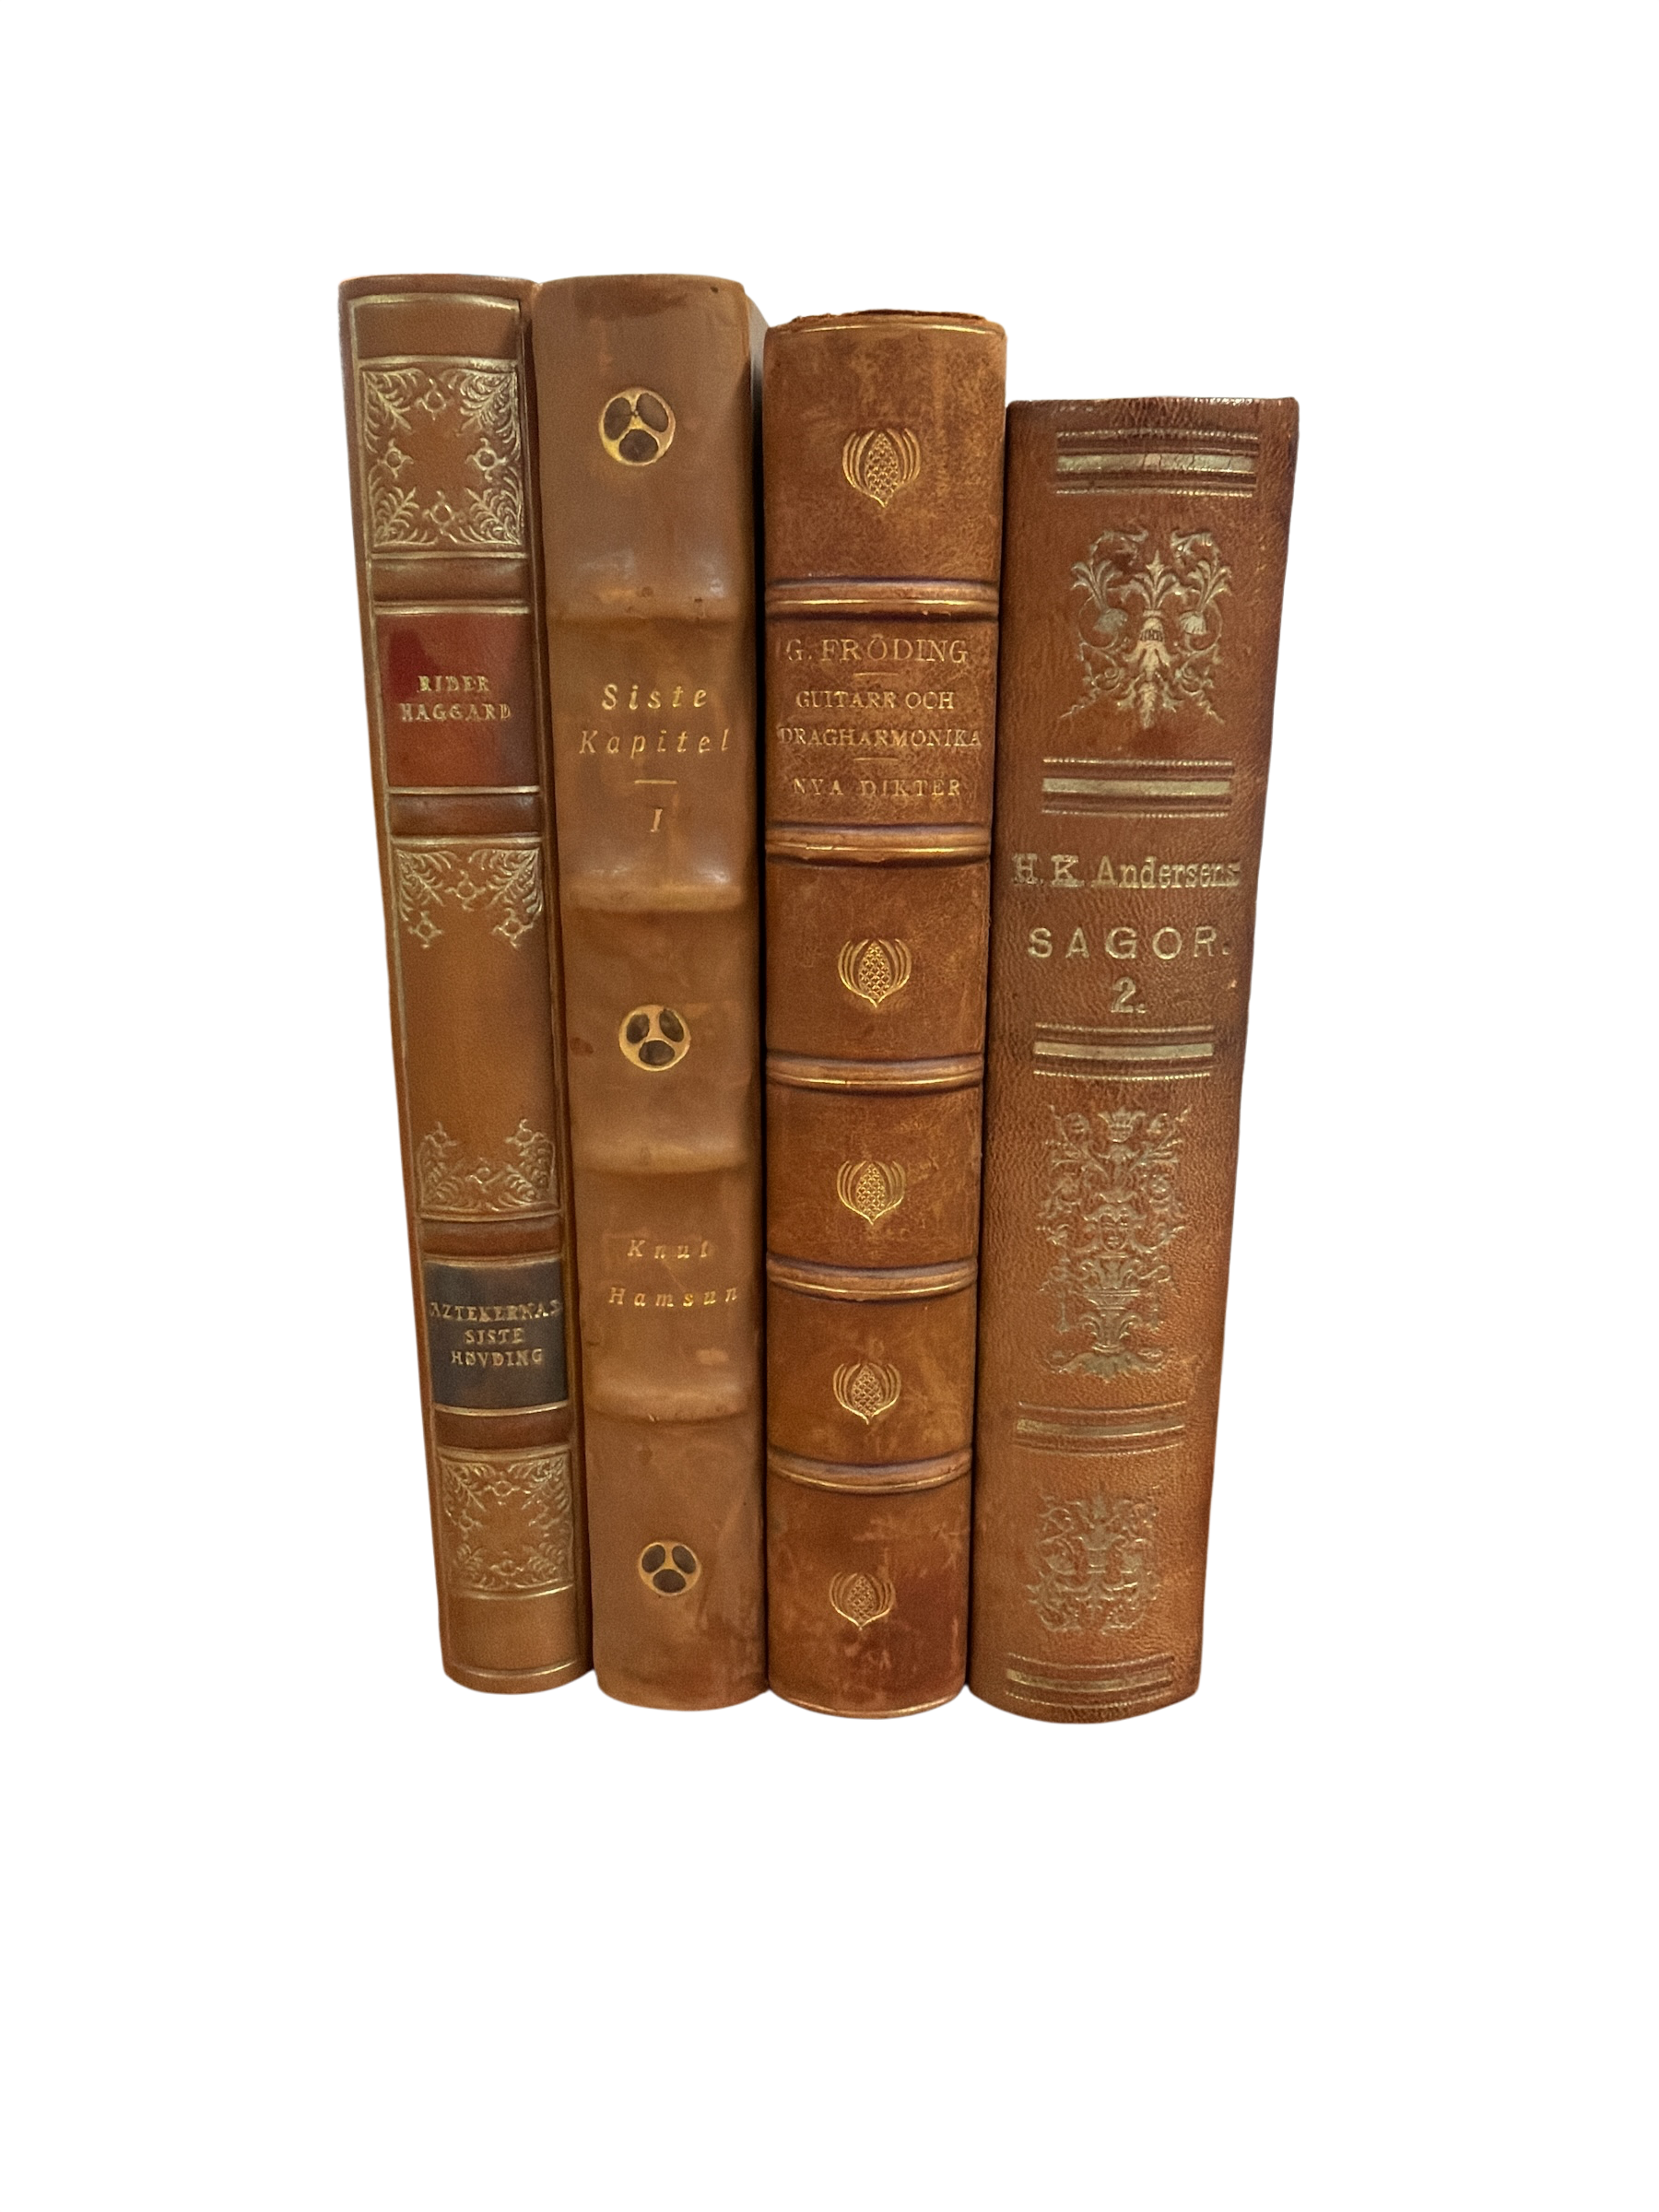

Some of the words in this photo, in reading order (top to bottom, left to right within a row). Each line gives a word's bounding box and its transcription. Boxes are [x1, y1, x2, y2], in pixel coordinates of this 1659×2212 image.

[785, 639, 812, 662] G.
[820, 633, 970, 664] FRÖDING
[418, 675, 489, 692] RIDER
[601, 683, 708, 711] Siste
[795, 690, 897, 709] GUITARR
[905, 691, 955, 710] OCH
[399, 702, 512, 722] HAGGARD
[579, 729, 730, 759] Kapitel
[778, 728, 982, 748] DRAGHARMONIKA
[793, 779, 844, 795] NYA
[860, 779, 961, 796] DIKTER
[1090, 855, 1241, 889] Andersens
[1028, 925, 1230, 960] SAGOR.
[1110, 976, 1147, 1014] 2.
[627, 1240, 710, 1259] Knut
[608, 1287, 738, 1308] Hamsun
[430, 1300, 561, 1323] AZTEKERNAS
[465, 1327, 525, 1346] SISTE
